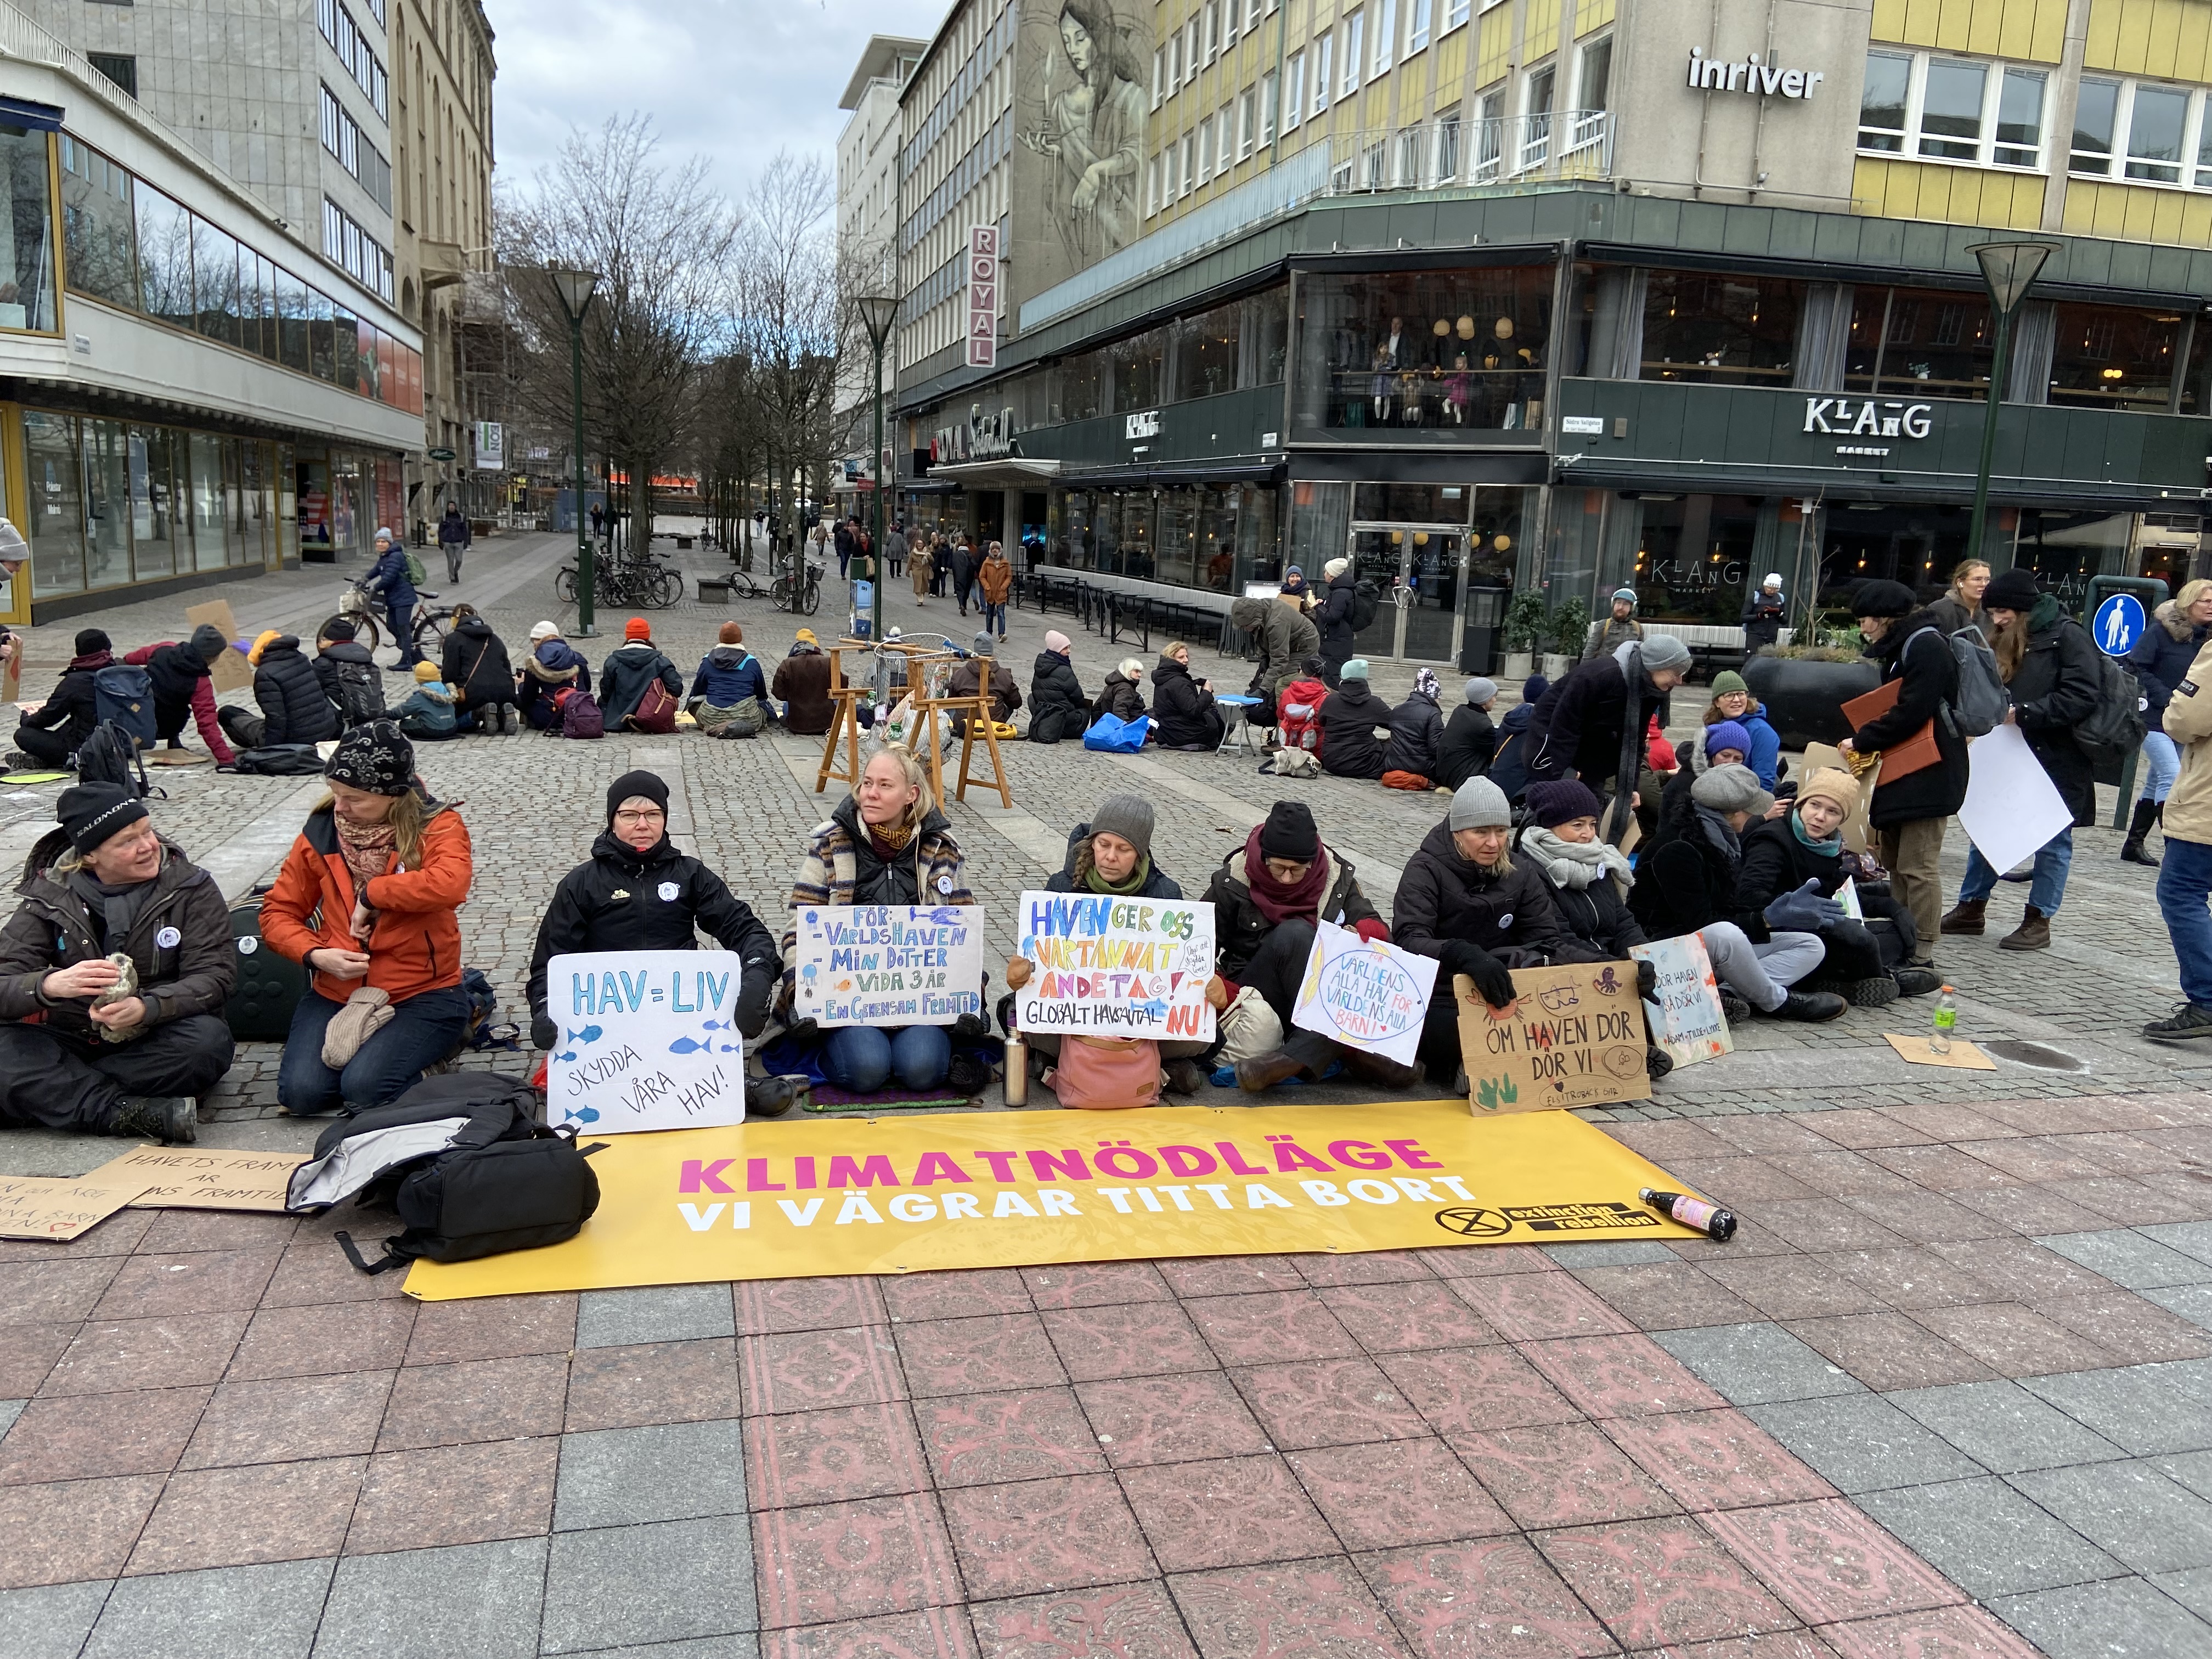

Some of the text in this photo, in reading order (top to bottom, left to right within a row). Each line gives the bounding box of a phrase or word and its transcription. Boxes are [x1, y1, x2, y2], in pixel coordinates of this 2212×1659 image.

[1688, 46, 1824, 99] inriver
[974, 231, 993, 362] ROYAL
[1803, 398, 1931, 438] KLANG
[936, 425, 967, 462] ROYAL
[1356, 551, 1401, 564] KLANG
[1413, 554, 1459, 567] KLANG
[1651, 559, 1741, 584] KLANG
[77, 801, 128, 837] SALOMON
[1032, 896, 1194, 941] HAVEN GER OSS
[1035, 935, 1179, 973] VARTANNAT
[910, 970, 923, 990] 3
[1331, 970, 1359, 993] ALLA
[1341, 956, 1405, 992] VÄRLDENS
[1675, 967, 1698, 984] HAVEN
[1026, 1000, 1091, 1025] GLOBALT
[1327, 985, 1407, 1030] VÄRLDENS ALLA
[1663, 995, 1675, 1012] SÅ
[1694, 991, 1702, 1003] VI
[1486, 1004, 1635, 1054] OM HAVEN DÖR
[1687, 1027, 1703, 1040] TILDE
[568, 1044, 642, 1096] SKYDDA
[1531, 1047, 1593, 1081] DÖR VI
[620, 1064, 729, 1115] VÅRA HAV!
[125, 1155, 222, 1168] HAVETS
[679, 1135, 1445, 1194] KLIMATNÖDLÄGE
[677, 1175, 1477, 1232] VI VÄGRAR TITTA BORT
[1509, 1204, 1613, 1218] extinction
[1554, 1214, 1656, 1229] rebellion
